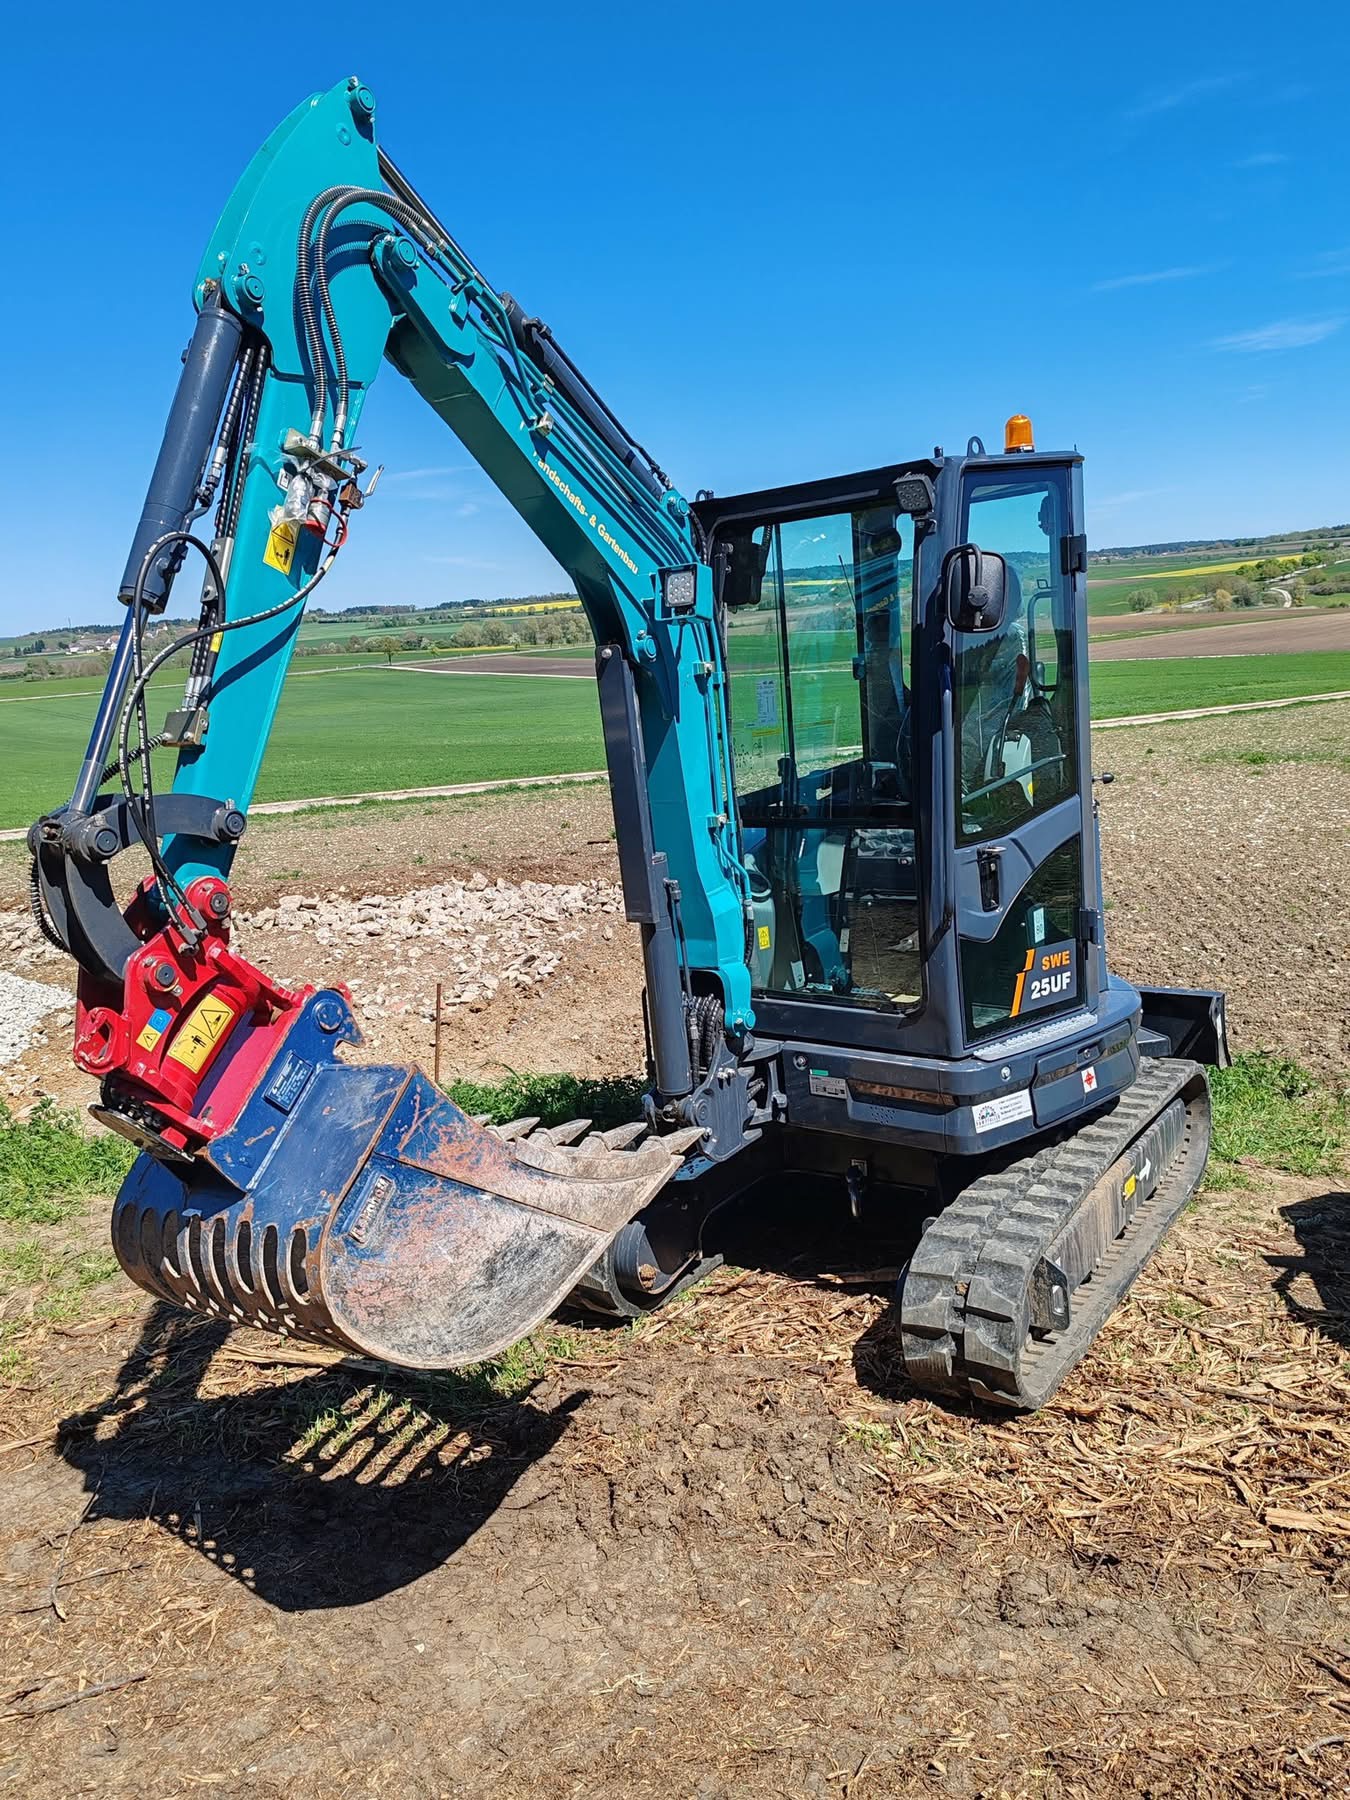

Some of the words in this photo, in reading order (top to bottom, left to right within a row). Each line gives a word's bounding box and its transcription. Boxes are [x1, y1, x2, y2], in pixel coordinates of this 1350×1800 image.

[532, 450, 588, 516] andschafts-
[588, 514, 597, 528] &
[597, 523, 639, 575] Gartenbau
[1041, 950, 1070, 971] SWE
[1031, 971, 1071, 1000] 25UF
